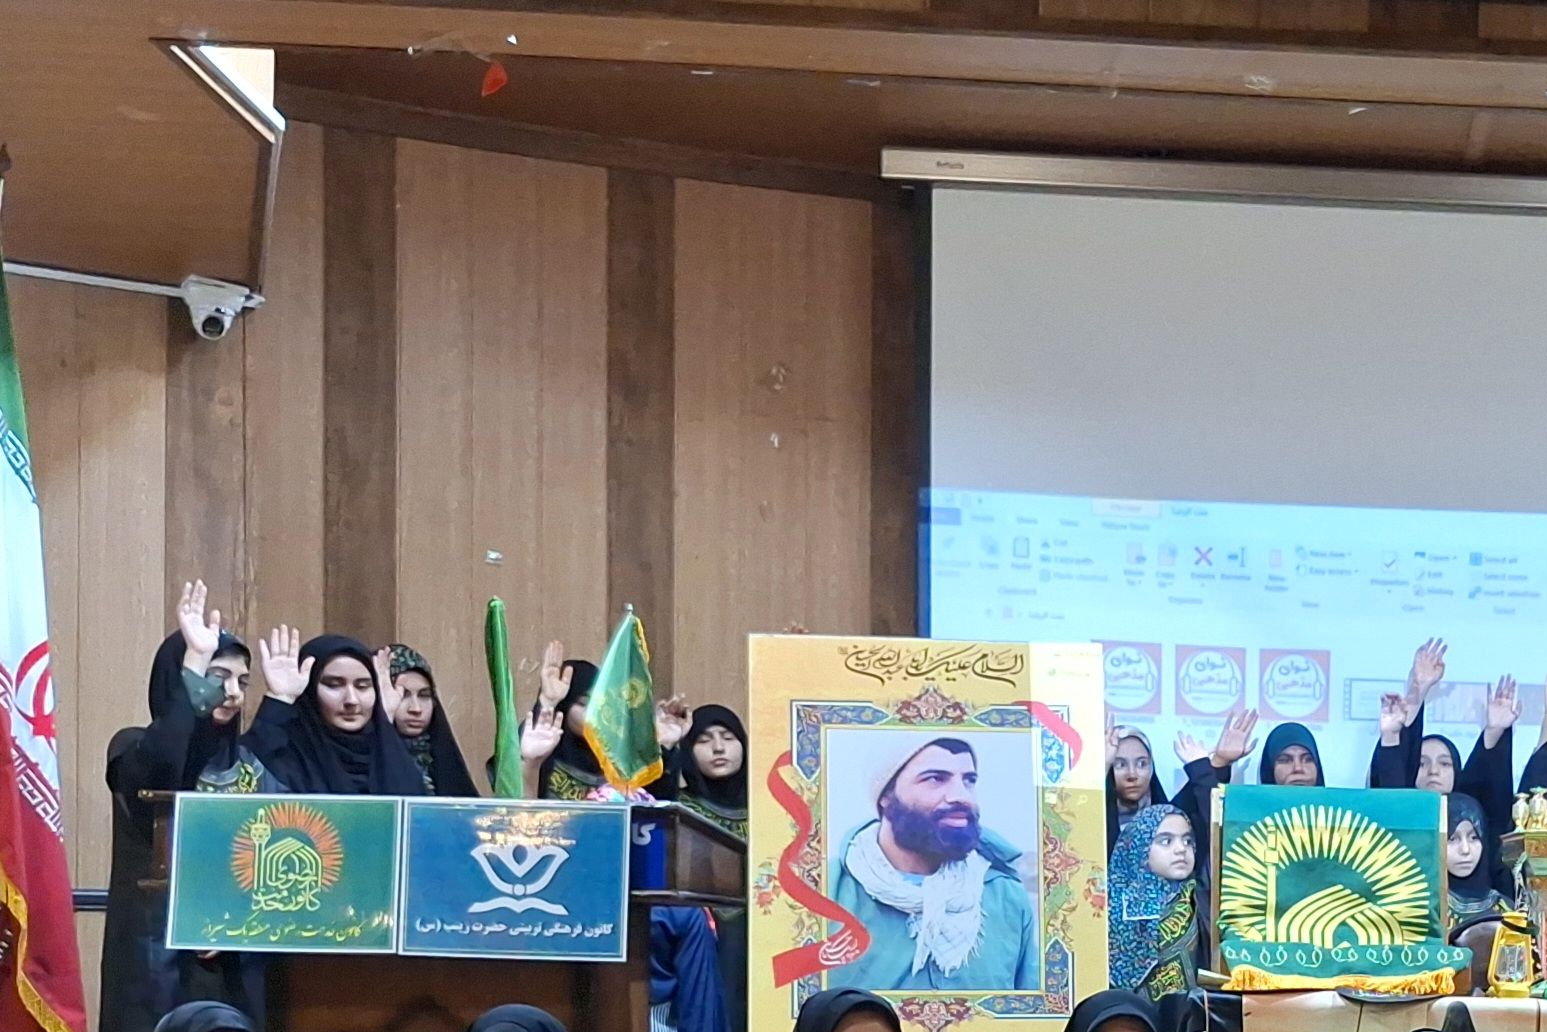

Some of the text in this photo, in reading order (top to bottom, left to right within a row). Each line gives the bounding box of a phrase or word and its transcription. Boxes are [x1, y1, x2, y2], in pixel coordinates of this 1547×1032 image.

[972, 648, 1024, 688] السلام
[442, 919, 470, 935] زینب
[472, 920, 508, 936] حضرت
[544, 922, 582, 939] فرهنگی
[584, 922, 613, 938] کانون
